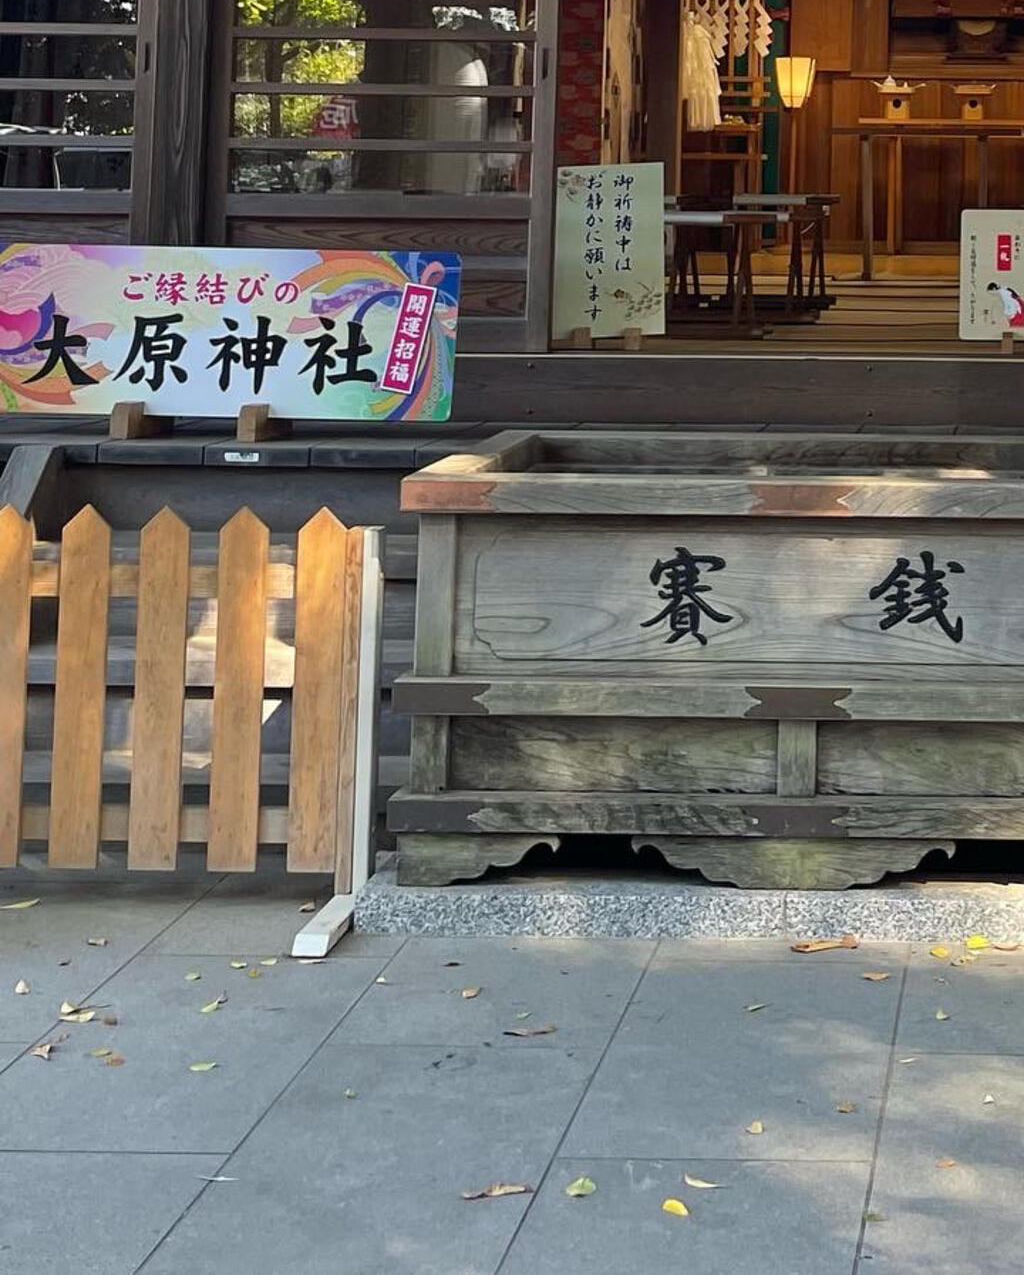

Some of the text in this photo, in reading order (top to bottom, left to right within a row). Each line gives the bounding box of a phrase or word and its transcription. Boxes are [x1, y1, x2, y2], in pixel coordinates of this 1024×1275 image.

[122, 272, 299, 306] ご縁結びの
[584, 172, 605, 321] お静かに願います
[21, 312, 378, 396] 大原神社
[390, 294, 427, 383] 開運招福
[640, 546, 964, 645] 賽銭
